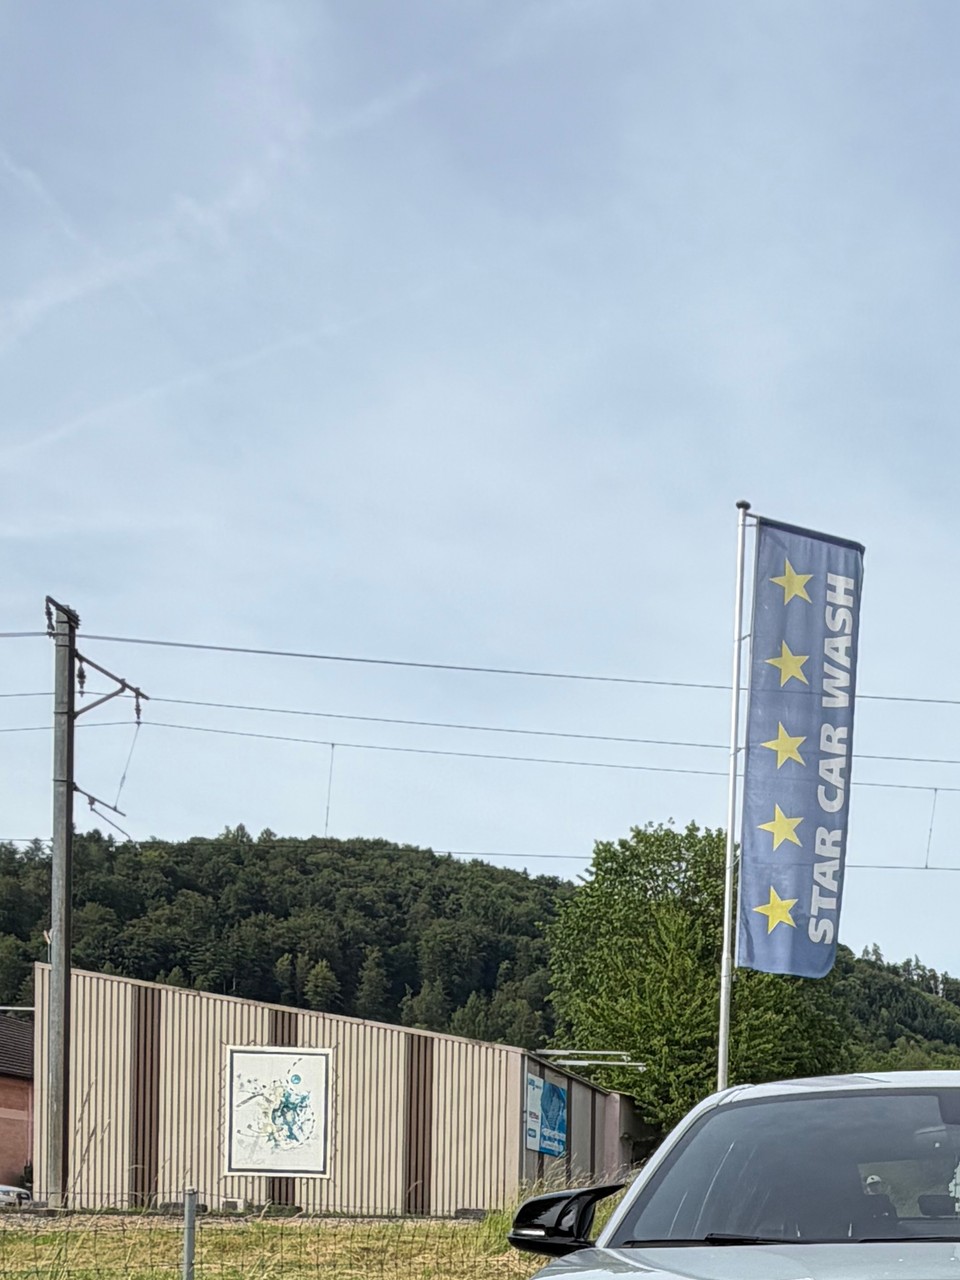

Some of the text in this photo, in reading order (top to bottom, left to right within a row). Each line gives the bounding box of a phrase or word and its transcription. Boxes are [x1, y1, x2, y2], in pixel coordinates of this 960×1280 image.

[808, 573, 854, 944] STAR CAR WASH
